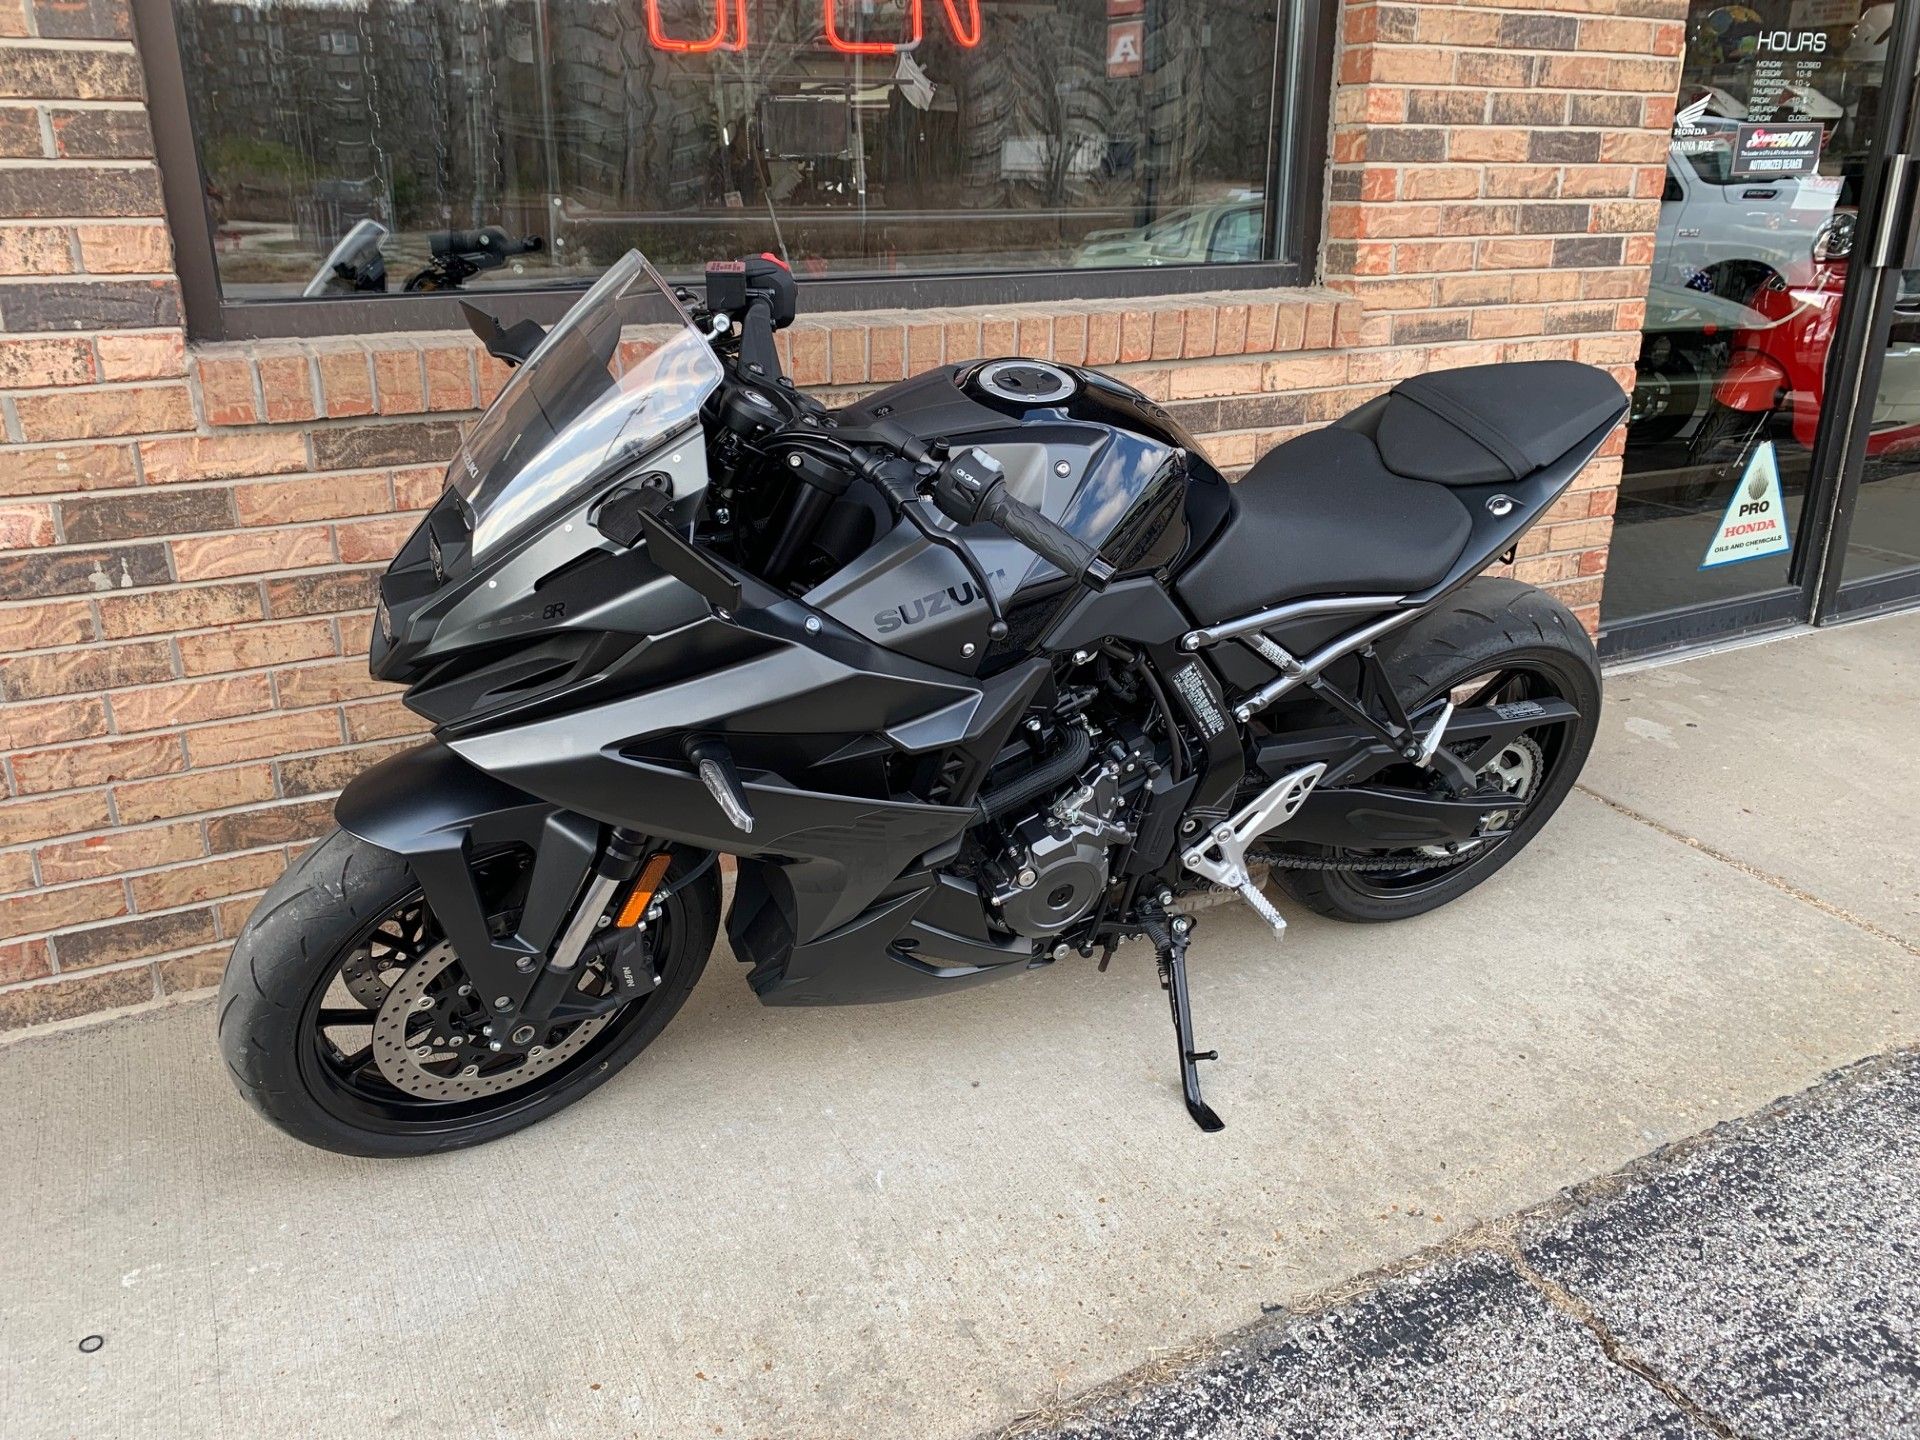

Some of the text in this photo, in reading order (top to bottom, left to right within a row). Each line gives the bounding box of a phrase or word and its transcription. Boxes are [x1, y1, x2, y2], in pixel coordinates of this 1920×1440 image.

[1757, 31, 1827, 52] HOURS
[1756, 60, 1783, 68] MONDAY
[1755, 69, 1783, 77] TUESDAY
[1753, 87, 1784, 95] THURSDAY
[1747, 114, 1773, 122] SUNDAY
[1669, 140, 1715, 151] WANNA RIDE
[1749, 159, 1803, 170] AUTHORIZED DEALER
[1739, 500, 1770, 517] PRO
[1724, 519, 1776, 538] HONDA
[1714, 535, 1782, 553] OILS AND CHEMICALS
[874, 568, 1006, 634] SUZU
